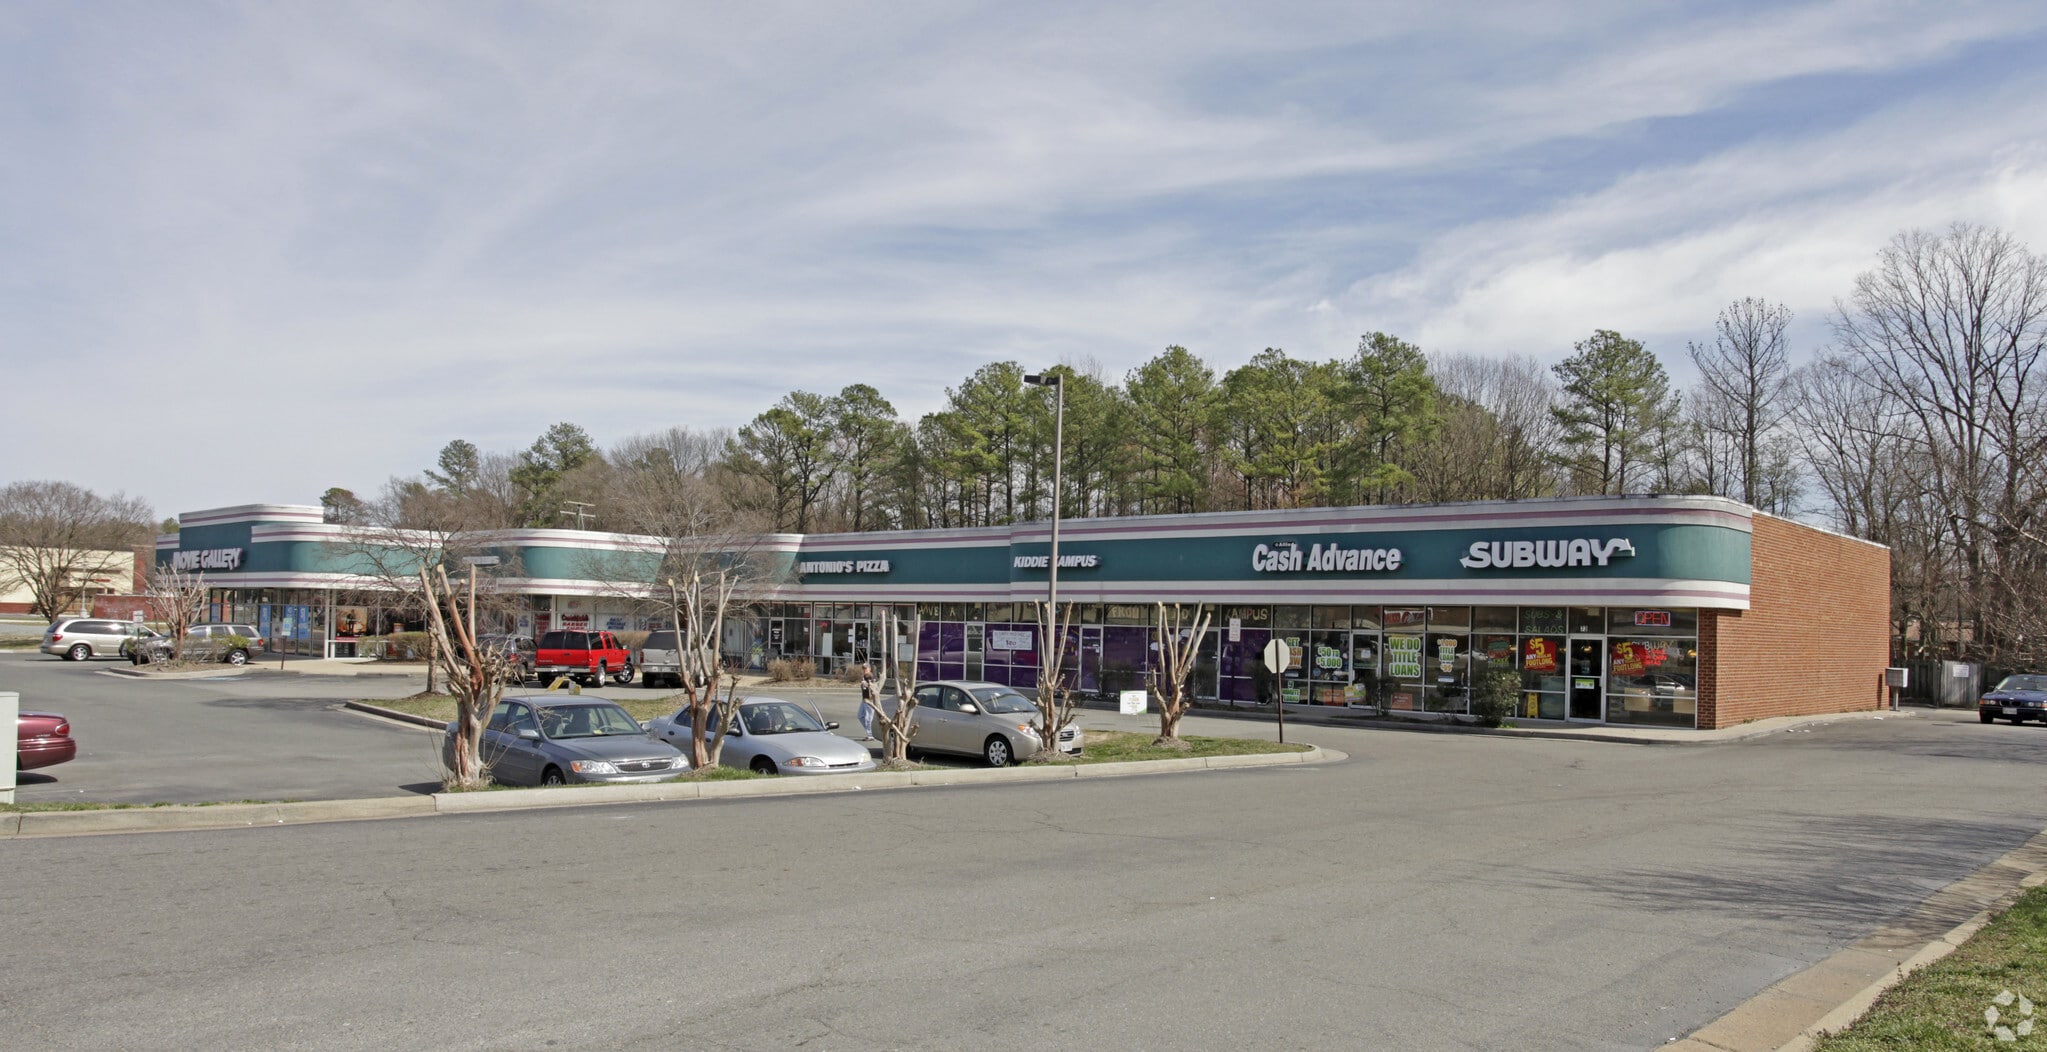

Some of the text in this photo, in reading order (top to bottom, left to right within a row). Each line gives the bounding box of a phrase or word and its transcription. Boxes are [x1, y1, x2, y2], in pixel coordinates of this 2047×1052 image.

[173, 548, 242, 570] MOVIE GALLERY
[1252, 543, 1402, 572] Cash Advance
[1459, 538, 1635, 568] SUBWAY
[800, 560, 889, 573] ANTONIO'S PIZZA
[1014, 555, 1098, 568] KIDDIE AMPUS
[1636, 611, 1670, 625] OPEN
[1389, 638, 1420, 649] WE DO
[1529, 638, 1545, 656] $5
[1392, 651, 1417, 662] TITLE
[1616, 642, 1634, 660] $5
[1390, 664, 1420, 676] LOANS
